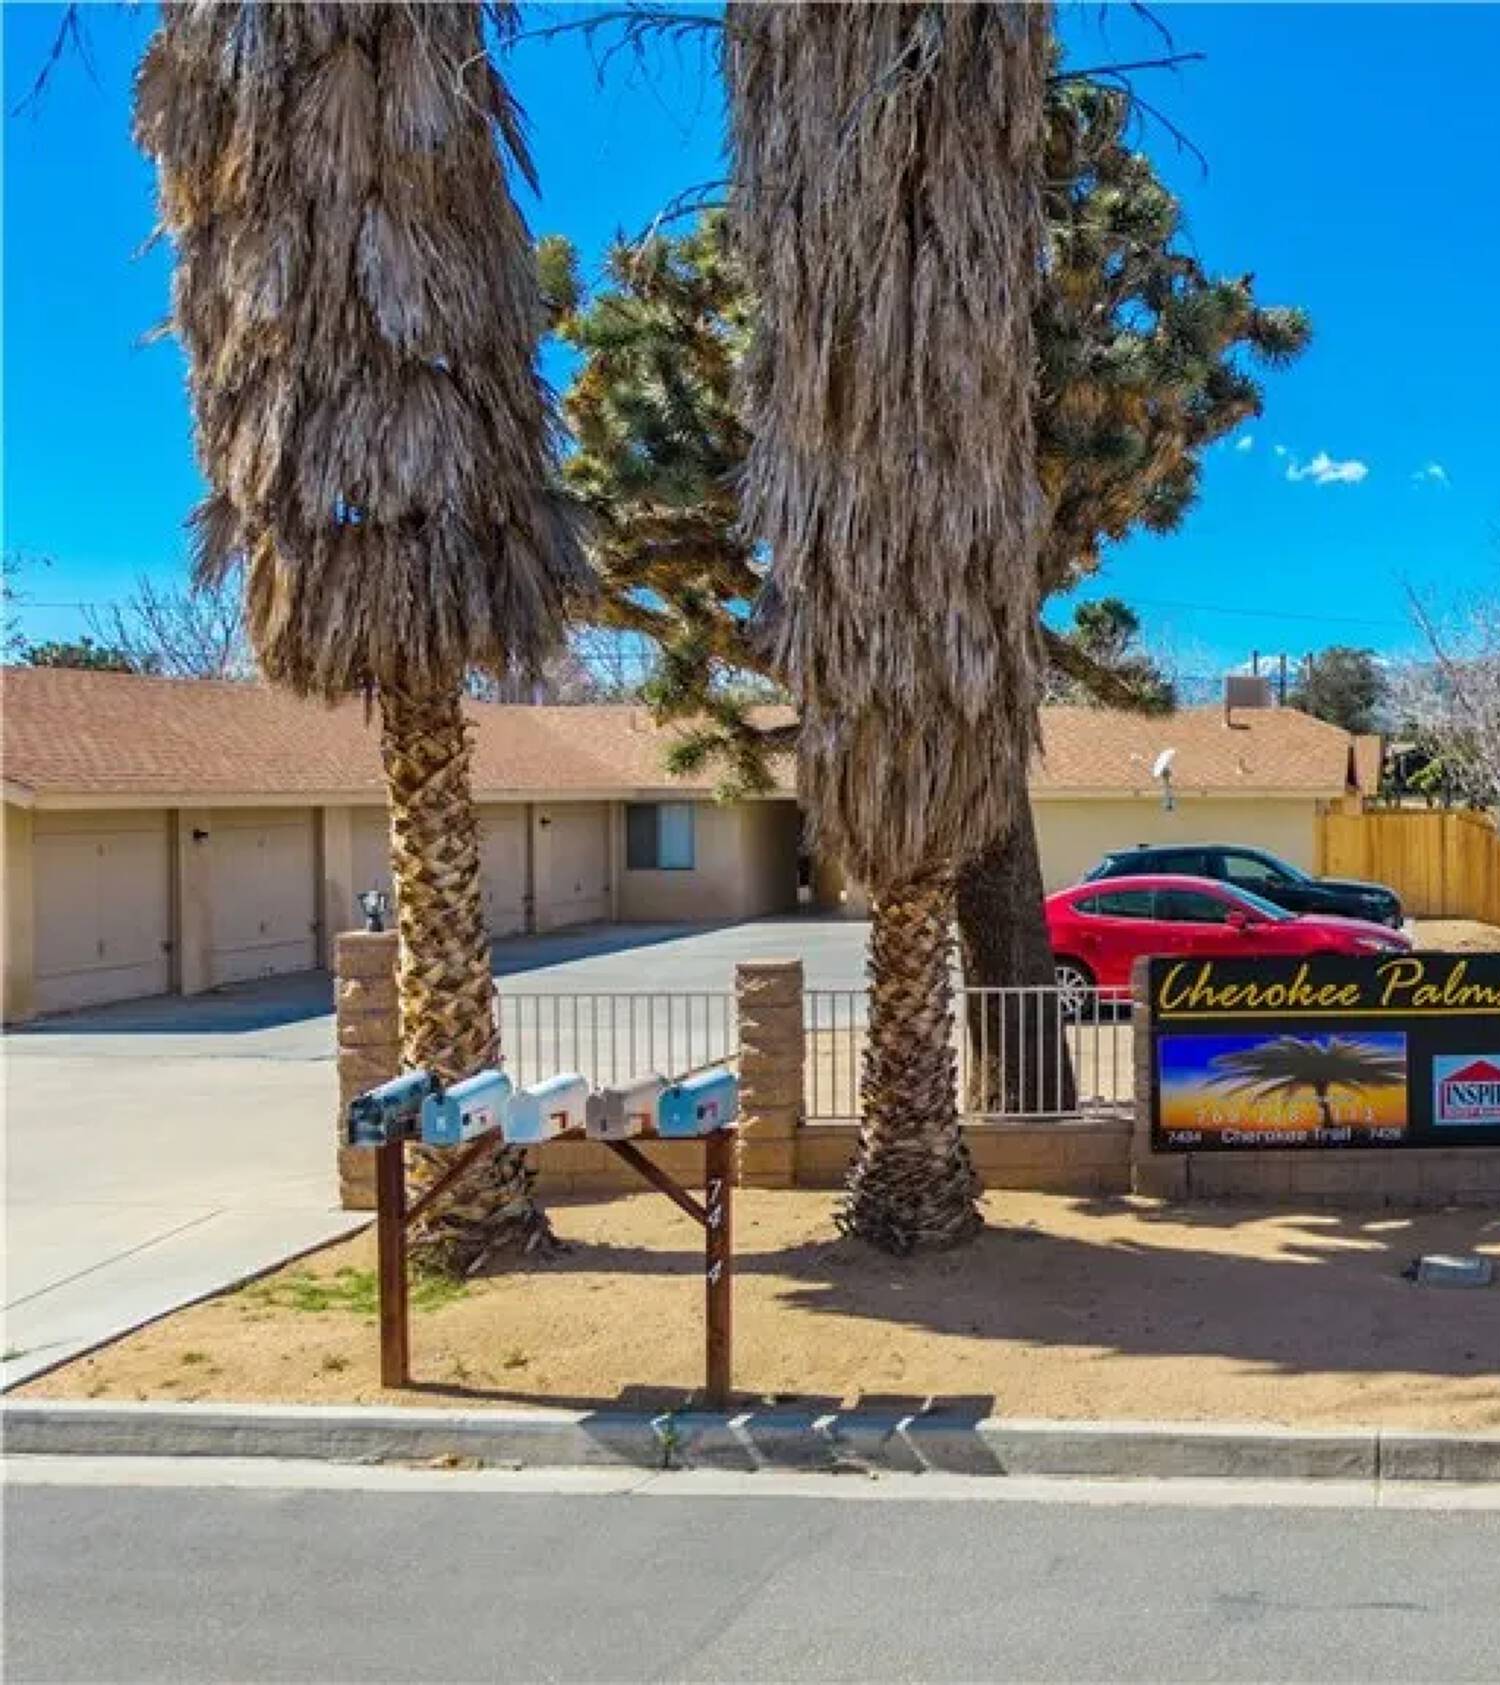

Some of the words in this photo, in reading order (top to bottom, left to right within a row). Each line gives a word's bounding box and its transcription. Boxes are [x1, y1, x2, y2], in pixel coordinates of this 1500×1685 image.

[1159, 960, 1361, 1009] Cherokee
[1221, 1129, 1307, 1144] Cherokee
[1314, 1125, 1351, 1142] Trail
